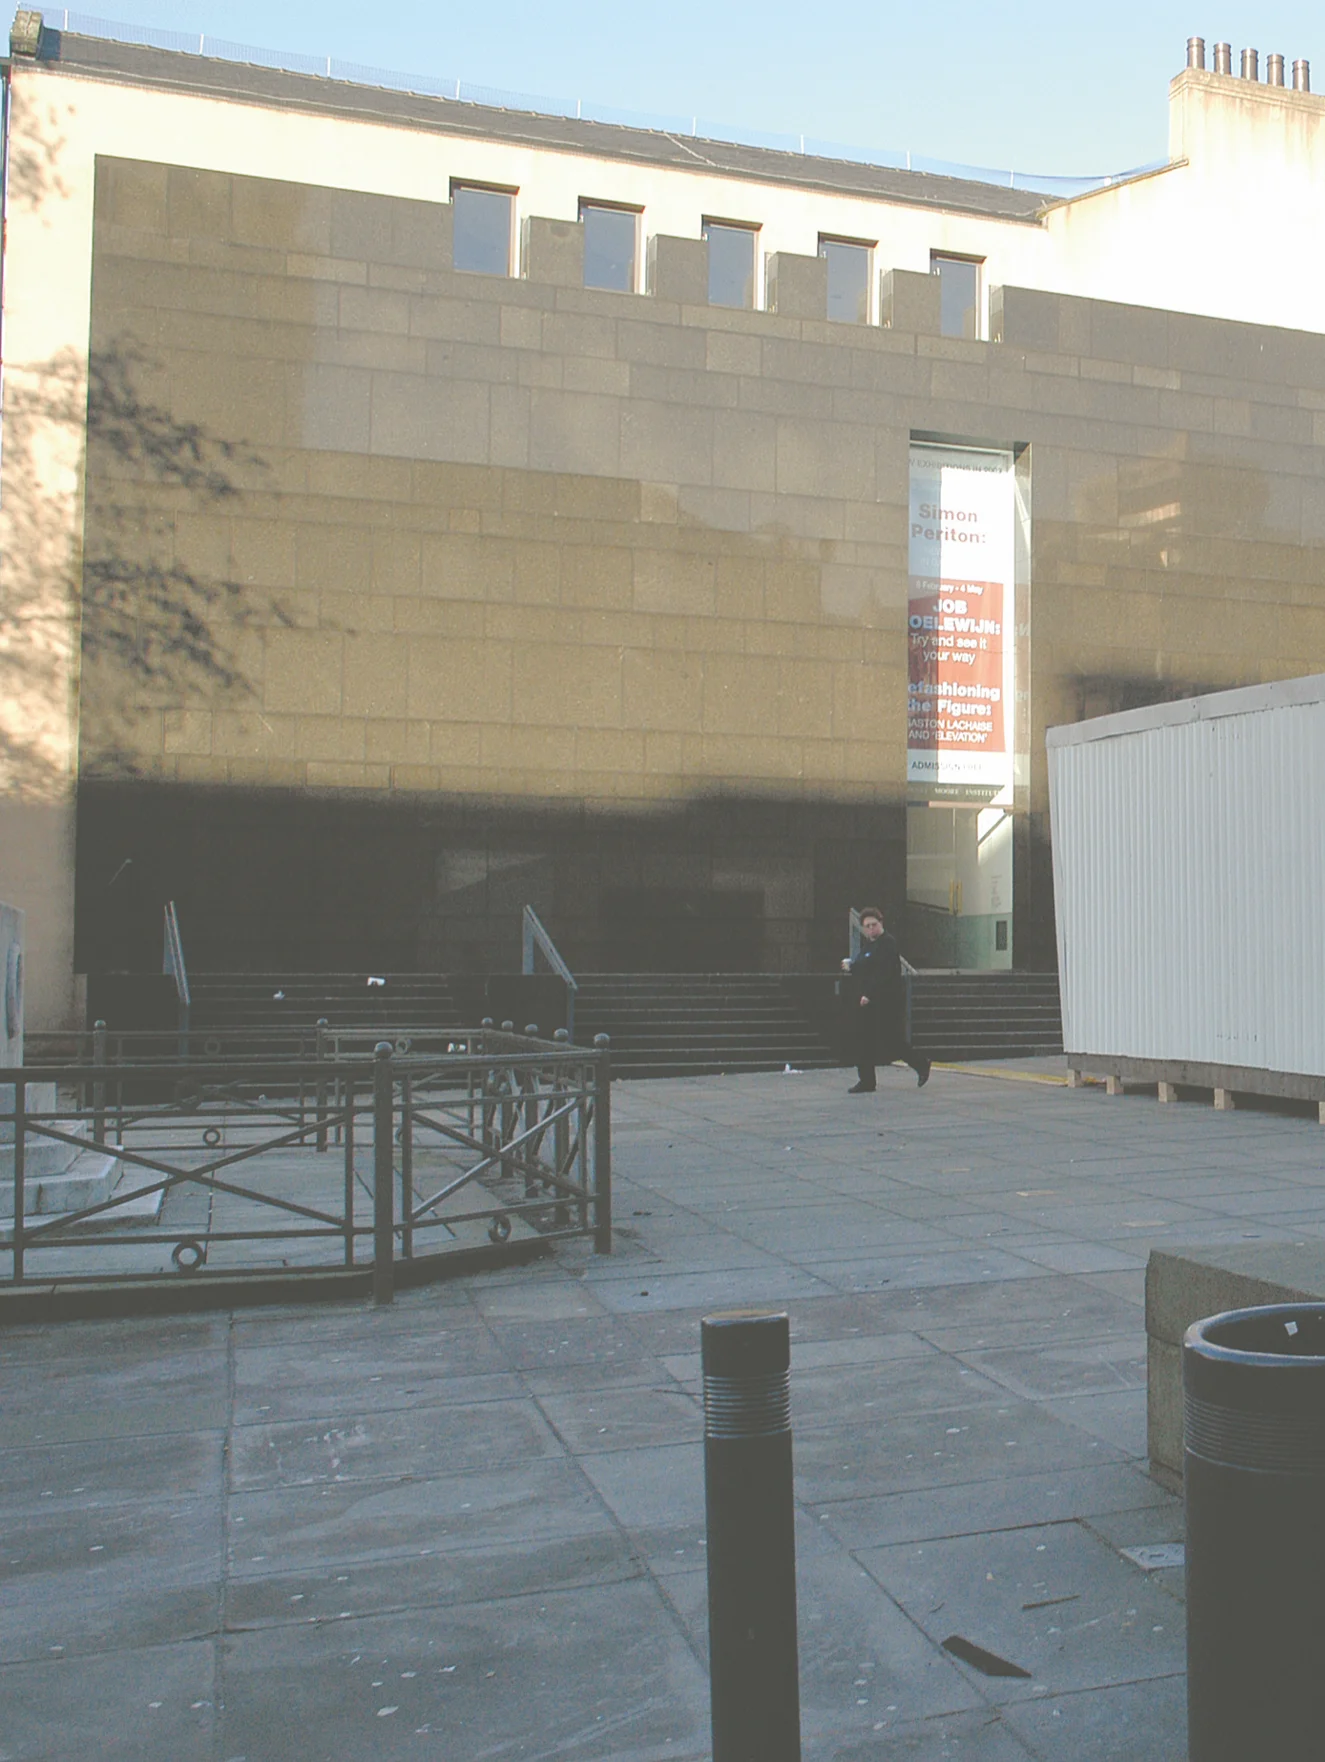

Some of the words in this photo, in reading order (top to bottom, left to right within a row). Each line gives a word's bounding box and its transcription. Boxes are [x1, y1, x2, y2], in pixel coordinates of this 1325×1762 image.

[919, 503, 978, 522] Simon
[911, 524, 986, 543] Periton:
[933, 598, 968, 614] JOB
[909, 615, 1001, 635] OELEWIJN:
[910, 632, 929, 648] Try
[931, 635, 954, 647] and
[956, 637, 978, 649] see
[979, 636, 987, 650] it
[923, 650, 950, 663] your
[951, 651, 976, 665] way
[908, 680, 1001, 702] efashioning
[937, 699, 992, 717] Figure:
[909, 729, 930, 740] AND
[946, 719, 993, 732] LACHAISE
[965, 788, 1001, 797] INSTITU
